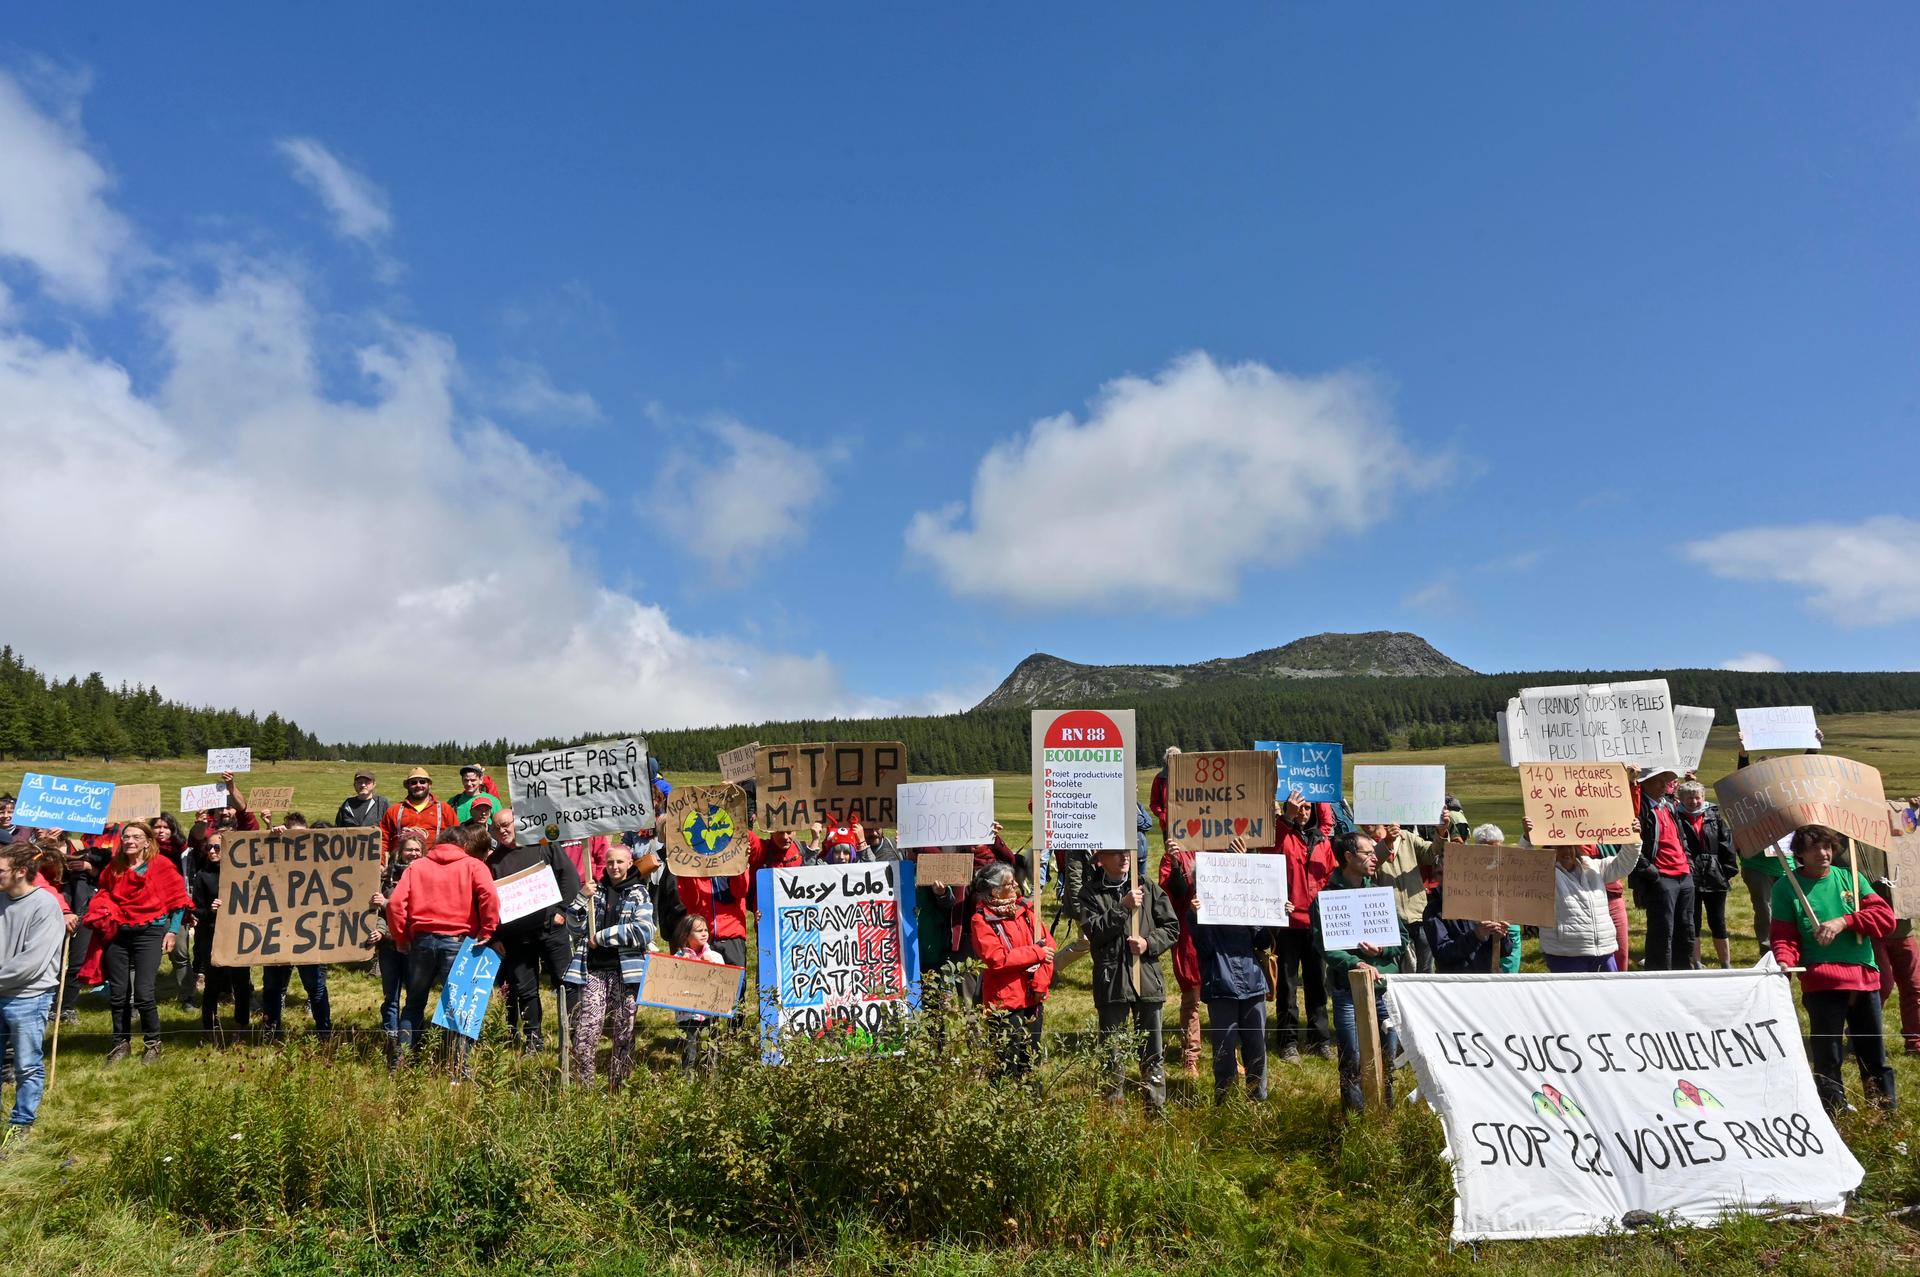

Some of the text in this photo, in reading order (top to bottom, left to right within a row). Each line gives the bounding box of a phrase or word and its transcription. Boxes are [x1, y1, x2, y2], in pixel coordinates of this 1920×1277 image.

[1516, 701, 1529, 717] A
[1537, 697, 1580, 717] GRANDS
[1584, 693, 1617, 713] COUPS
[1631, 694, 1665, 713] PELLES
[1061, 727, 1105, 741] RN 88
[1519, 727, 1530, 739] LA
[1620, 717, 1648, 735] SERA
[1045, 749, 1123, 762] ECOLOGIE
[1301, 747, 1332, 763] LW
[1549, 743, 1577, 761] PLUS
[1602, 736, 1653, 758] BELLE
[509, 751, 575, 780] TOUCHE
[586, 749, 617, 767] PAS
[767, 747, 898, 792] STOP
[1195, 757, 1225, 783] 88
[1290, 763, 1330, 778] investit
[1045, 768, 1123, 780] Projet productiviste
[1526, 766, 1554, 782] 140
[526, 780, 548, 799] MA
[1045, 778, 1083, 788] Obsolète
[1309, 782, 1335, 794] sucs
[52, 778, 68, 792] La
[74, 781, 110, 805] région
[1045, 789, 1092, 801] Saccageur
[1175, 783, 1246, 802] NUANCES
[1530, 785, 1543, 800] de
[1548, 783, 1568, 799] vie
[91, 797, 103, 810] le
[667, 794, 699, 816] NOUS
[1045, 800, 1098, 809] Inhabitable
[1199, 805, 1211, 815] DE
[1544, 803, 1555, 820] 3
[520, 803, 646, 831] STOP PROJET RN88
[765, 796, 897, 830] MASSACR
[1045, 809, 1097, 819] Tiroir-caisse
[1045, 820, 1083, 829] Illusoire
[1547, 823, 1566, 840] de
[1045, 830, 1089, 840] Wauquiez
[229, 831, 381, 868] CETTE ROUTE
[667, 830, 748, 869] PLUS LE TEMPS
[1045, 840, 1103, 849] Evidemment
[1199, 871, 1265, 885] avons besoin
[228, 865, 353, 915] N'A PAS
[779, 875, 837, 904] Vas-y
[1326, 904, 1348, 913] LOLO
[1364, 902, 1386, 910] LOLO
[1373, 910, 1390, 918] FAIS
[1323, 912, 1352, 921] TU FAIS
[1363, 918, 1391, 927] FAUSSE
[237, 910, 377, 955] DE SENS
[1325, 921, 1353, 929] FAUSSE
[1325, 929, 1351, 937] ROUTE
[1363, 927, 1389, 935] ROUTE
[1435, 1017, 1788, 1074] LES SUCS SE SOULEVENT
[1471, 1121, 1551, 1169] STOP
[1723, 1112, 1825, 1161] RN88
